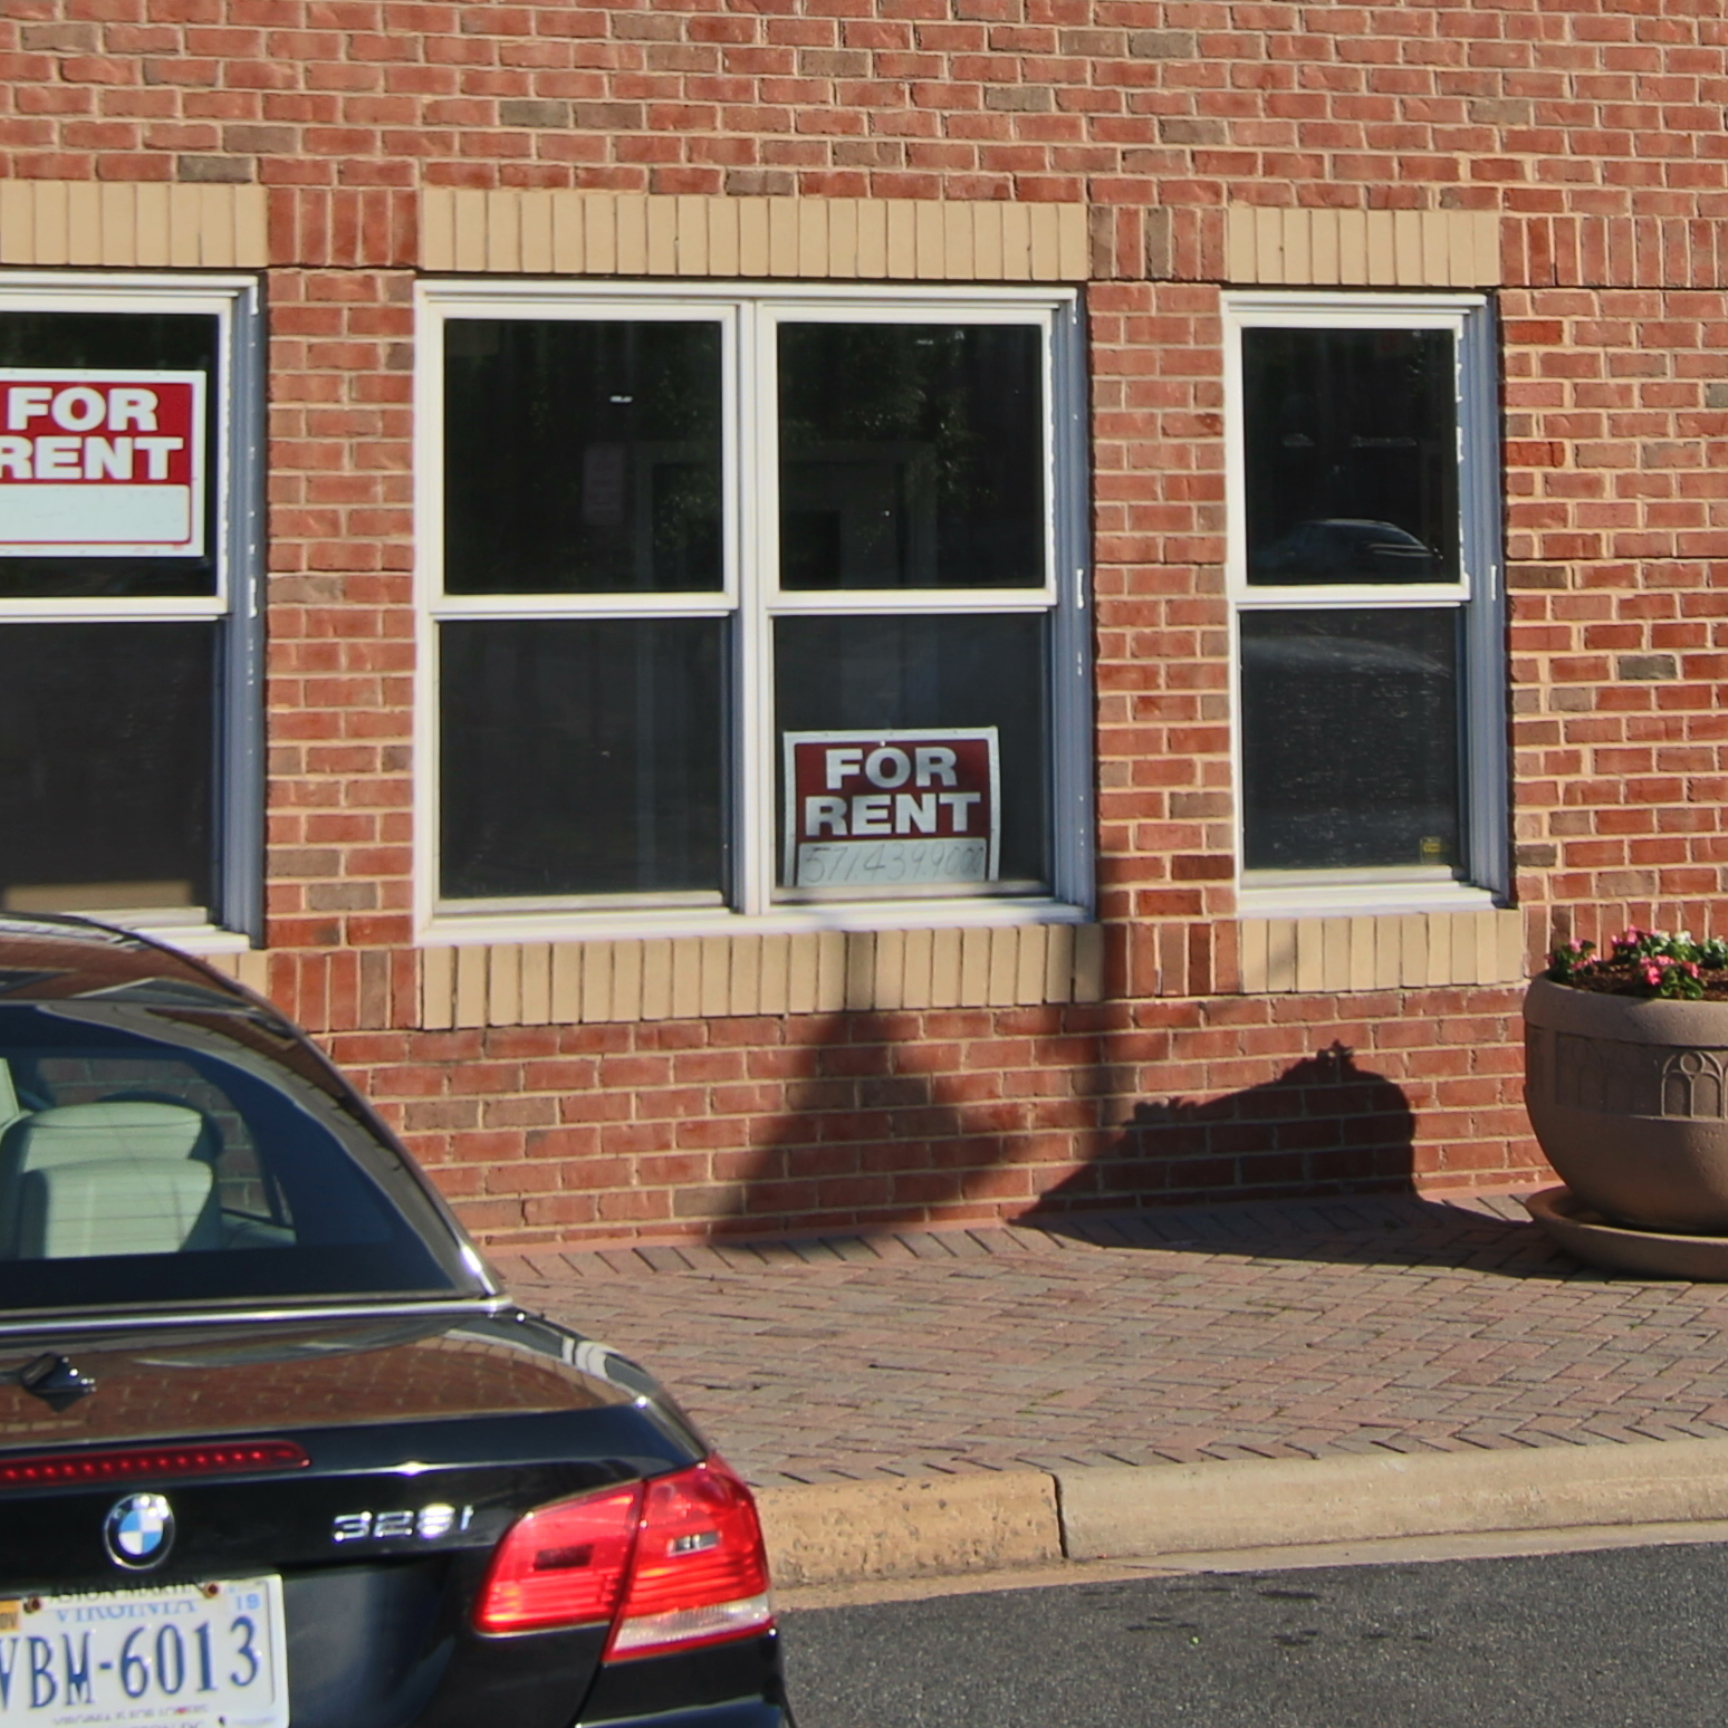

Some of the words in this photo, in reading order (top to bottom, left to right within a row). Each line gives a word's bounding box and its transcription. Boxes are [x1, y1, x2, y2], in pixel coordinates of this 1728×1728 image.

[7, 386, 159, 432] FOR
[825, 746, 958, 790] FOR
[805, 792, 982, 837] RENT
[332, 1503, 474, 1542] 328i
[57, 1600, 198, 1623] VIRGINIA
